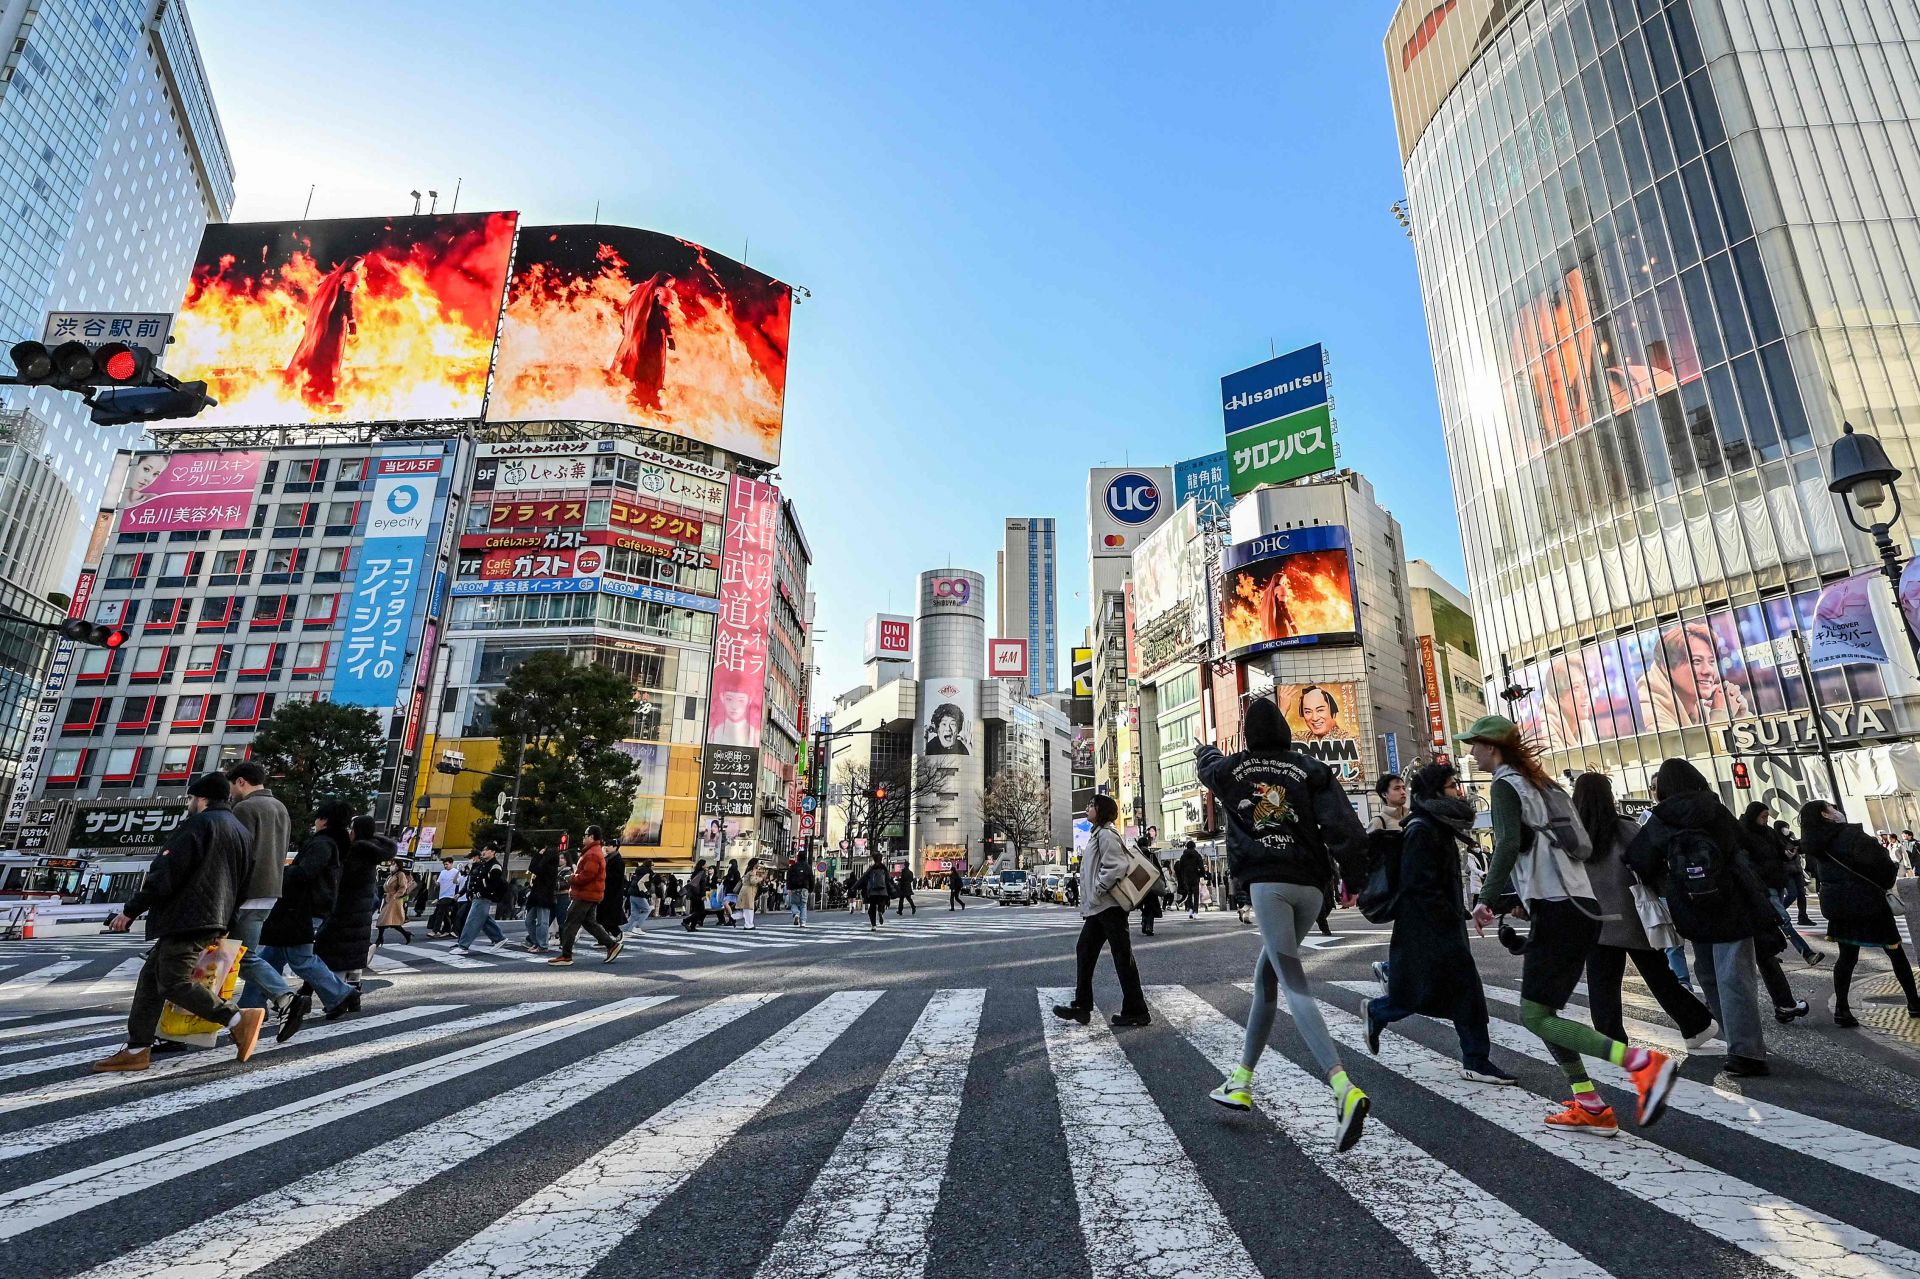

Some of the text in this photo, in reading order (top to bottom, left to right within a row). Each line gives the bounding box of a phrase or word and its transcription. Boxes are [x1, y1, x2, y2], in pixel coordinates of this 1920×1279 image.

[54, 317, 160, 338] 渋谷駅前
[1224, 371, 1323, 410] Hisamitsu
[491, 442, 590, 455] しゃぶしゃぶバイキング
[1233, 425, 1326, 475] サロンパス
[189, 459, 255, 474] 品川スキン
[384, 460, 435, 472] 当ビル5F
[530, 462, 586, 480] しゃぶ葉
[635, 446, 726, 480] しゃぶしゃぶバイキング
[187, 472, 246, 487] クリニック
[477, 469, 496, 481] 9F
[1186, 465, 1222, 490] 龍角散
[669, 476, 722, 504] しゃぶ葉
[138, 505, 242, 525] 品川美容外科
[493, 503, 582, 523] プライス
[610, 504, 699, 538] コンタクト
[374, 516, 423, 531] eyecity
[543, 531, 588, 549] ガスト
[1252, 535, 1290, 556] DHC
[487, 559, 511, 569] Café
[512, 555, 569, 578] ガスト
[671, 547, 712, 568] ガスト
[460, 560, 482, 574] 7F
[714, 476, 758, 673] 日本武道館
[75, 575, 91, 603] 外貨両替
[456, 580, 592, 593] AEON 英会話イーオン 6F
[750, 485, 778, 675] 水曜日のカンパネラ
[607, 582, 717, 610] AEON 英会話イーオン
[932, 577, 971, 605] 109
[346, 559, 392, 680] アイシティ
[373, 558, 414, 679] コンタクトの
[884, 624, 906, 636] UNI
[1815, 630, 1873, 642] キルカバー
[883, 637, 906, 648] QLO
[1275, 638, 1300, 648] Channel
[1422, 638, 1436, 698] クスリのことなら
[1429, 702, 1444, 741] 三千里
[40, 705, 54, 713] 3F
[1709, 704, 1886, 753] TSUTAYA
[1290, 740, 1359, 761] DMM
[713, 762, 750, 773] カンパネラ
[737, 789, 753, 801] (土)
[739, 782, 753, 790] 2024
[25, 811, 40, 824] 薬
[21, 828, 49, 838] 処方せん
[119, 834, 155, 844] CARER
[25, 838, 41, 847] 受付
